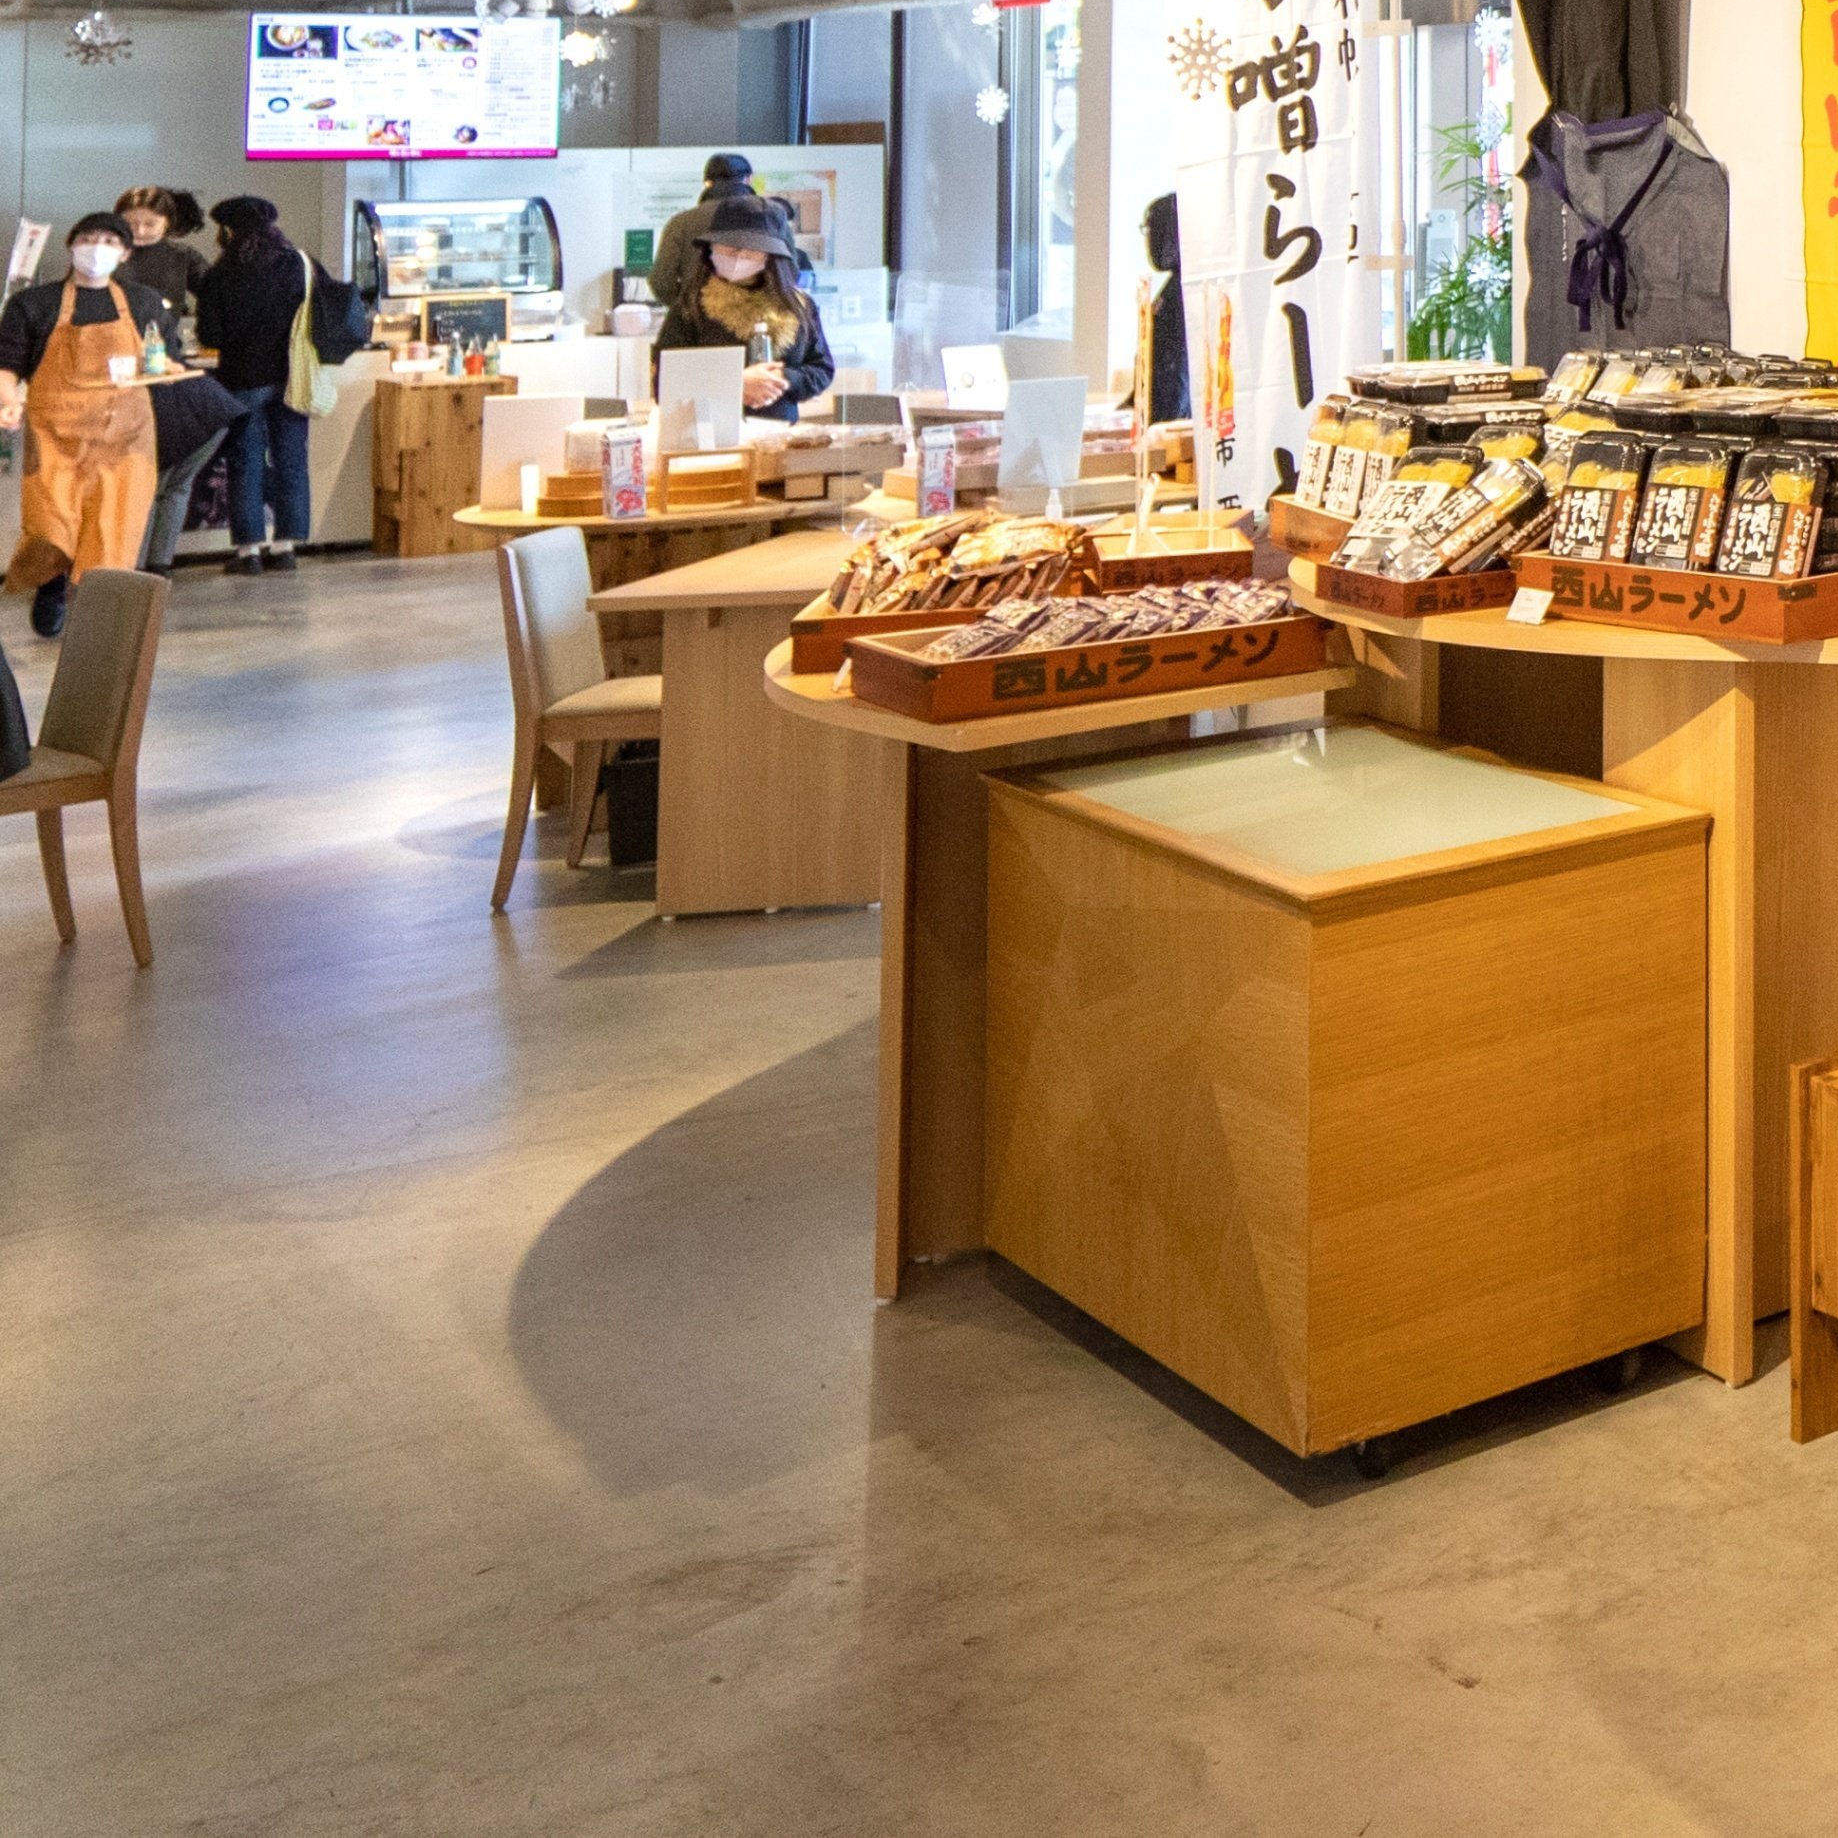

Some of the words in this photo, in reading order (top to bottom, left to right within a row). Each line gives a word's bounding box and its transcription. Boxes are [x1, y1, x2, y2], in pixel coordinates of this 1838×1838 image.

[1551, 566, 1747, 624] 西山ラーメン
[992, 629, 1280, 701] 西山ラーメン
